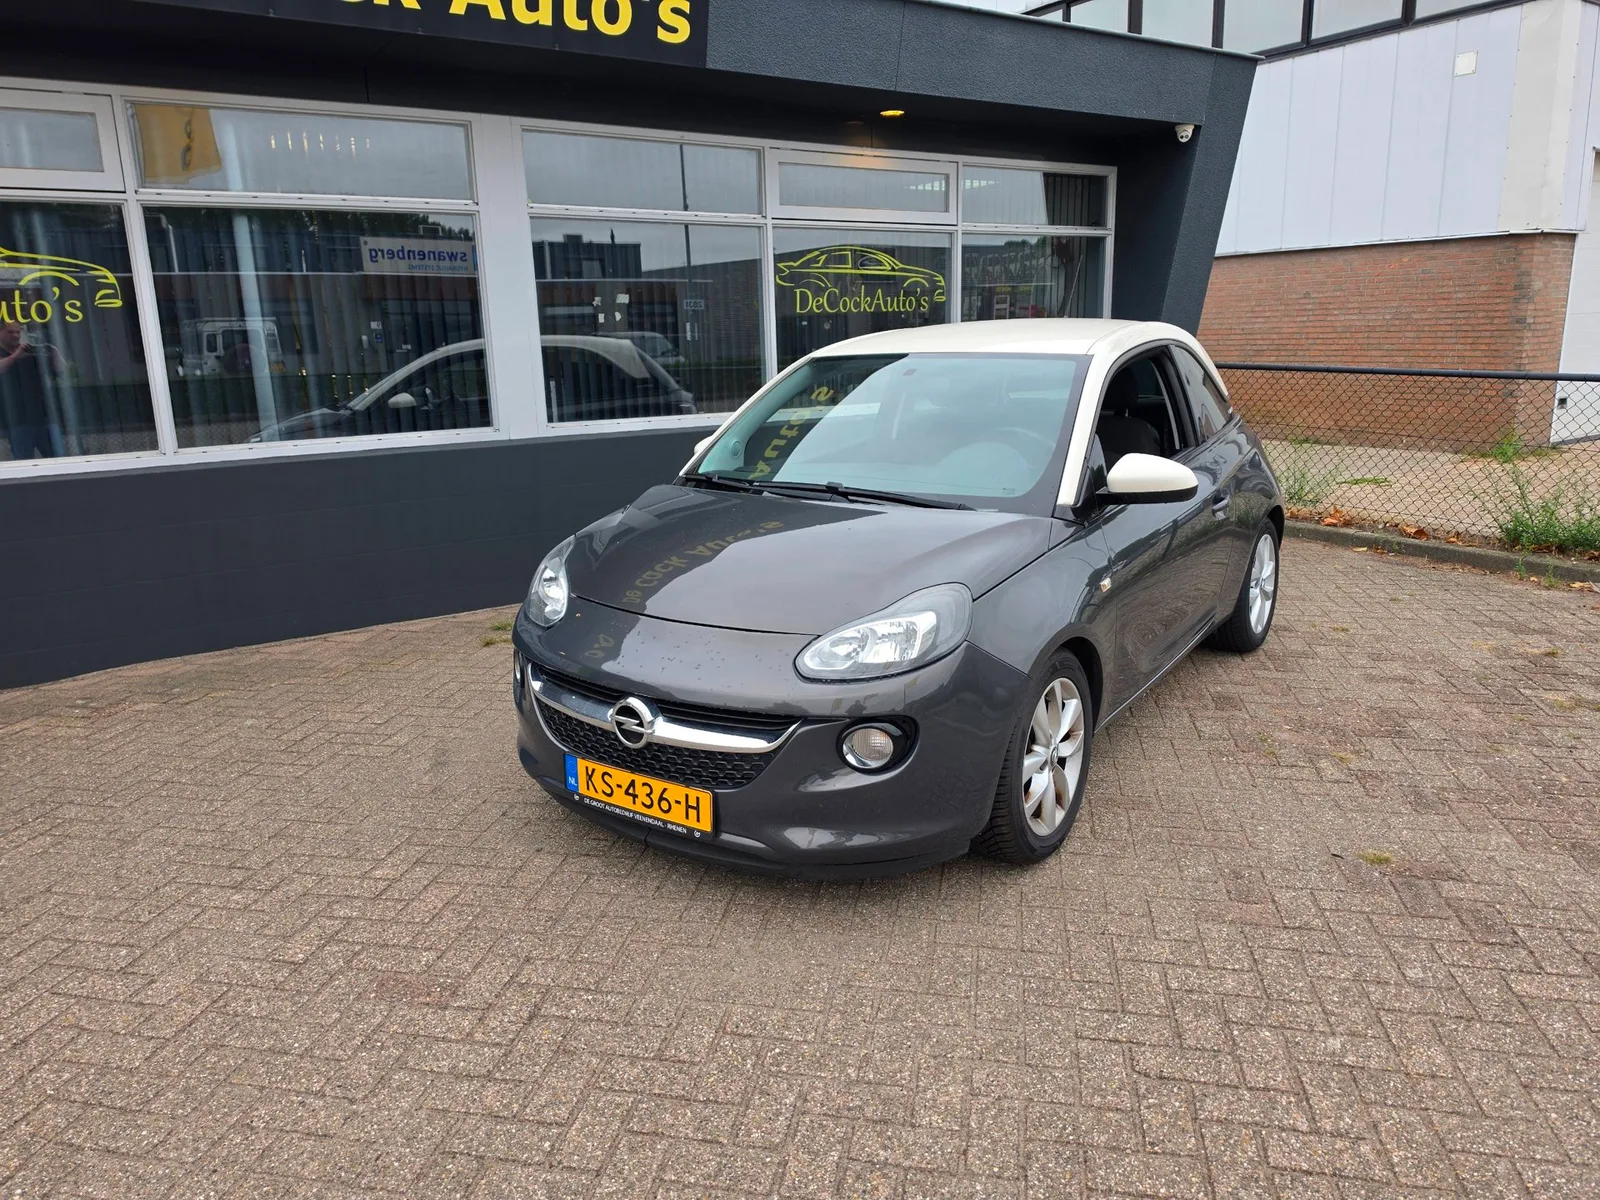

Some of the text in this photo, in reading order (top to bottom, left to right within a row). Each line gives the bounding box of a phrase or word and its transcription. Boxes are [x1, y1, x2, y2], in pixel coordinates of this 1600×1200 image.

[448, 0, 691, 43] utos
[794, 285, 929, 313] DeCockAuto's
[568, 776, 577, 786] NL
[585, 766, 700, 823] KS-436-H
[667, 822, 687, 834] RHENEN
